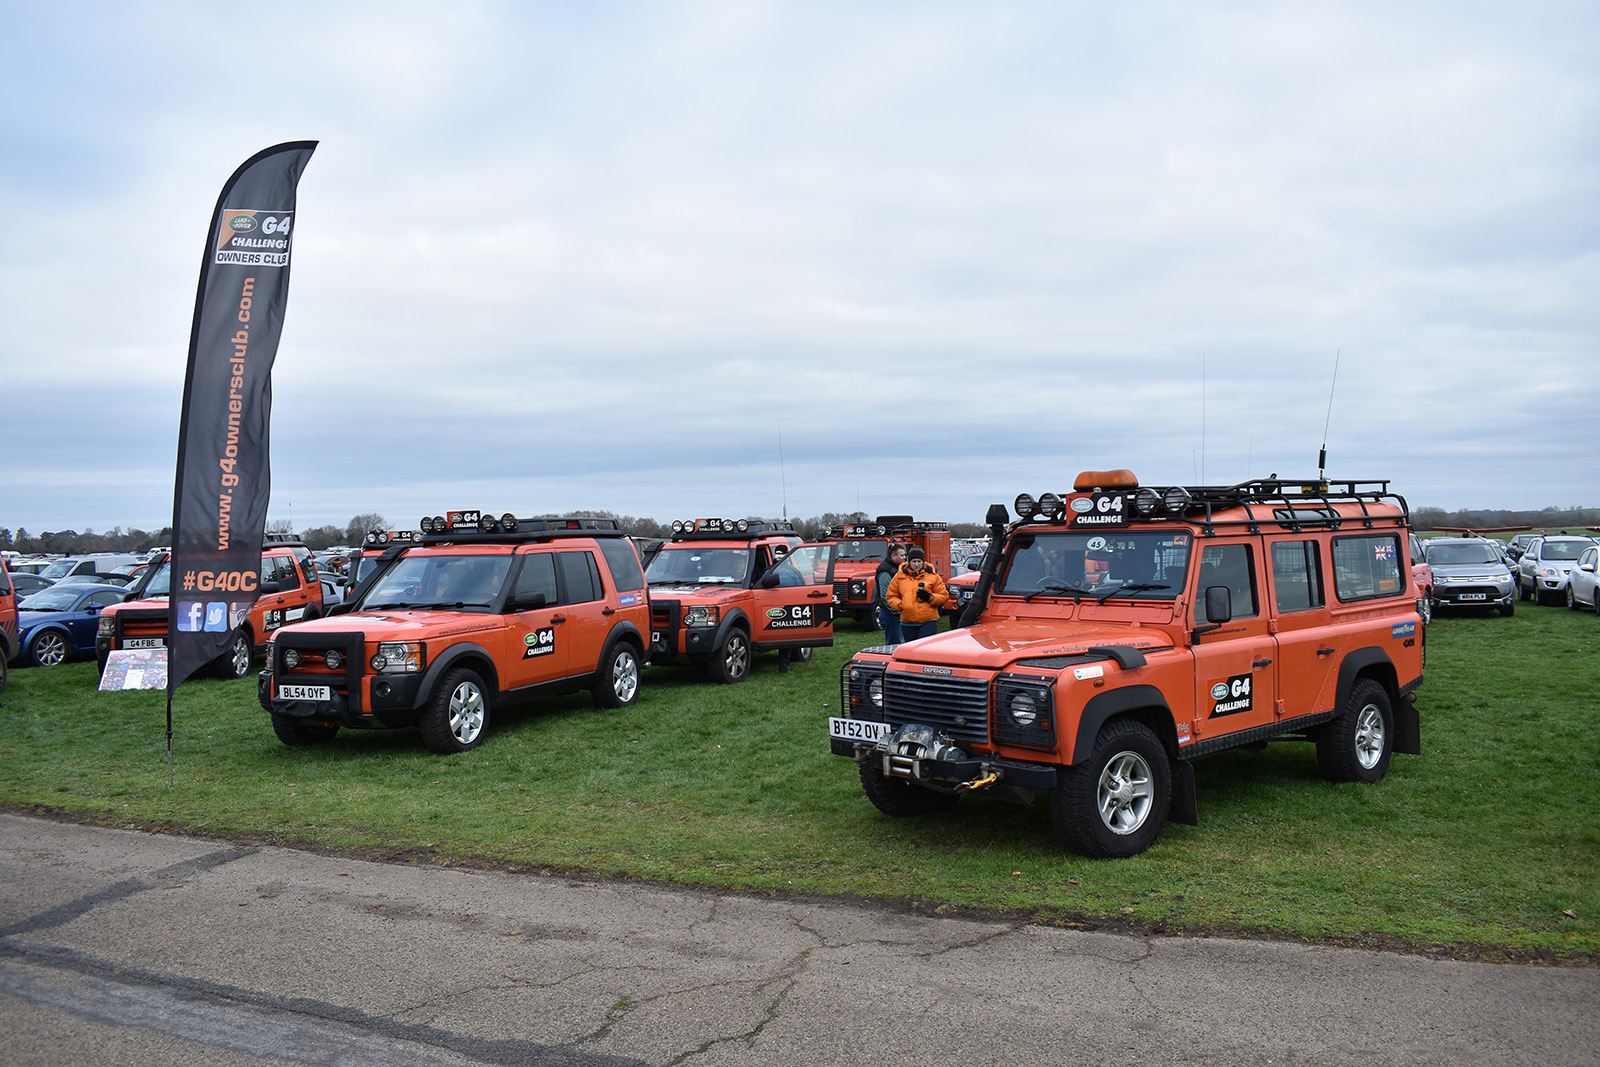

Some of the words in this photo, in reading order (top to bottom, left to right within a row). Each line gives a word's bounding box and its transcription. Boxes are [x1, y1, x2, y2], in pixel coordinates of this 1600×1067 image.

[261, 216, 291, 236] G4
[216, 252, 261, 264] OWNERS
[263, 254, 287, 265] CLUB
[218, 277, 256, 550] www.g4ownersclub.com
[1097, 496, 1122, 512] G4
[463, 513, 478, 522] G4
[709, 519, 721, 527] G4
[1076, 515, 1122, 524] CHALLENGE
[1090, 541, 1102, 549] 45
[273, 610, 281, 622] G4
[791, 605, 812, 619] G4
[771, 619, 812, 628] CHALLENGE
[1392, 624, 1415, 635] GOODYEAR
[539, 629, 554, 644] G4
[527, 645, 554, 656] CHALLENGE
[283, 687, 306, 698] BL54
[307, 687, 325, 699] OYF
[1231, 677, 1251, 698] G4
[1215, 698, 1250, 713] CHALLENGE
[833, 720, 862, 738] BT52
